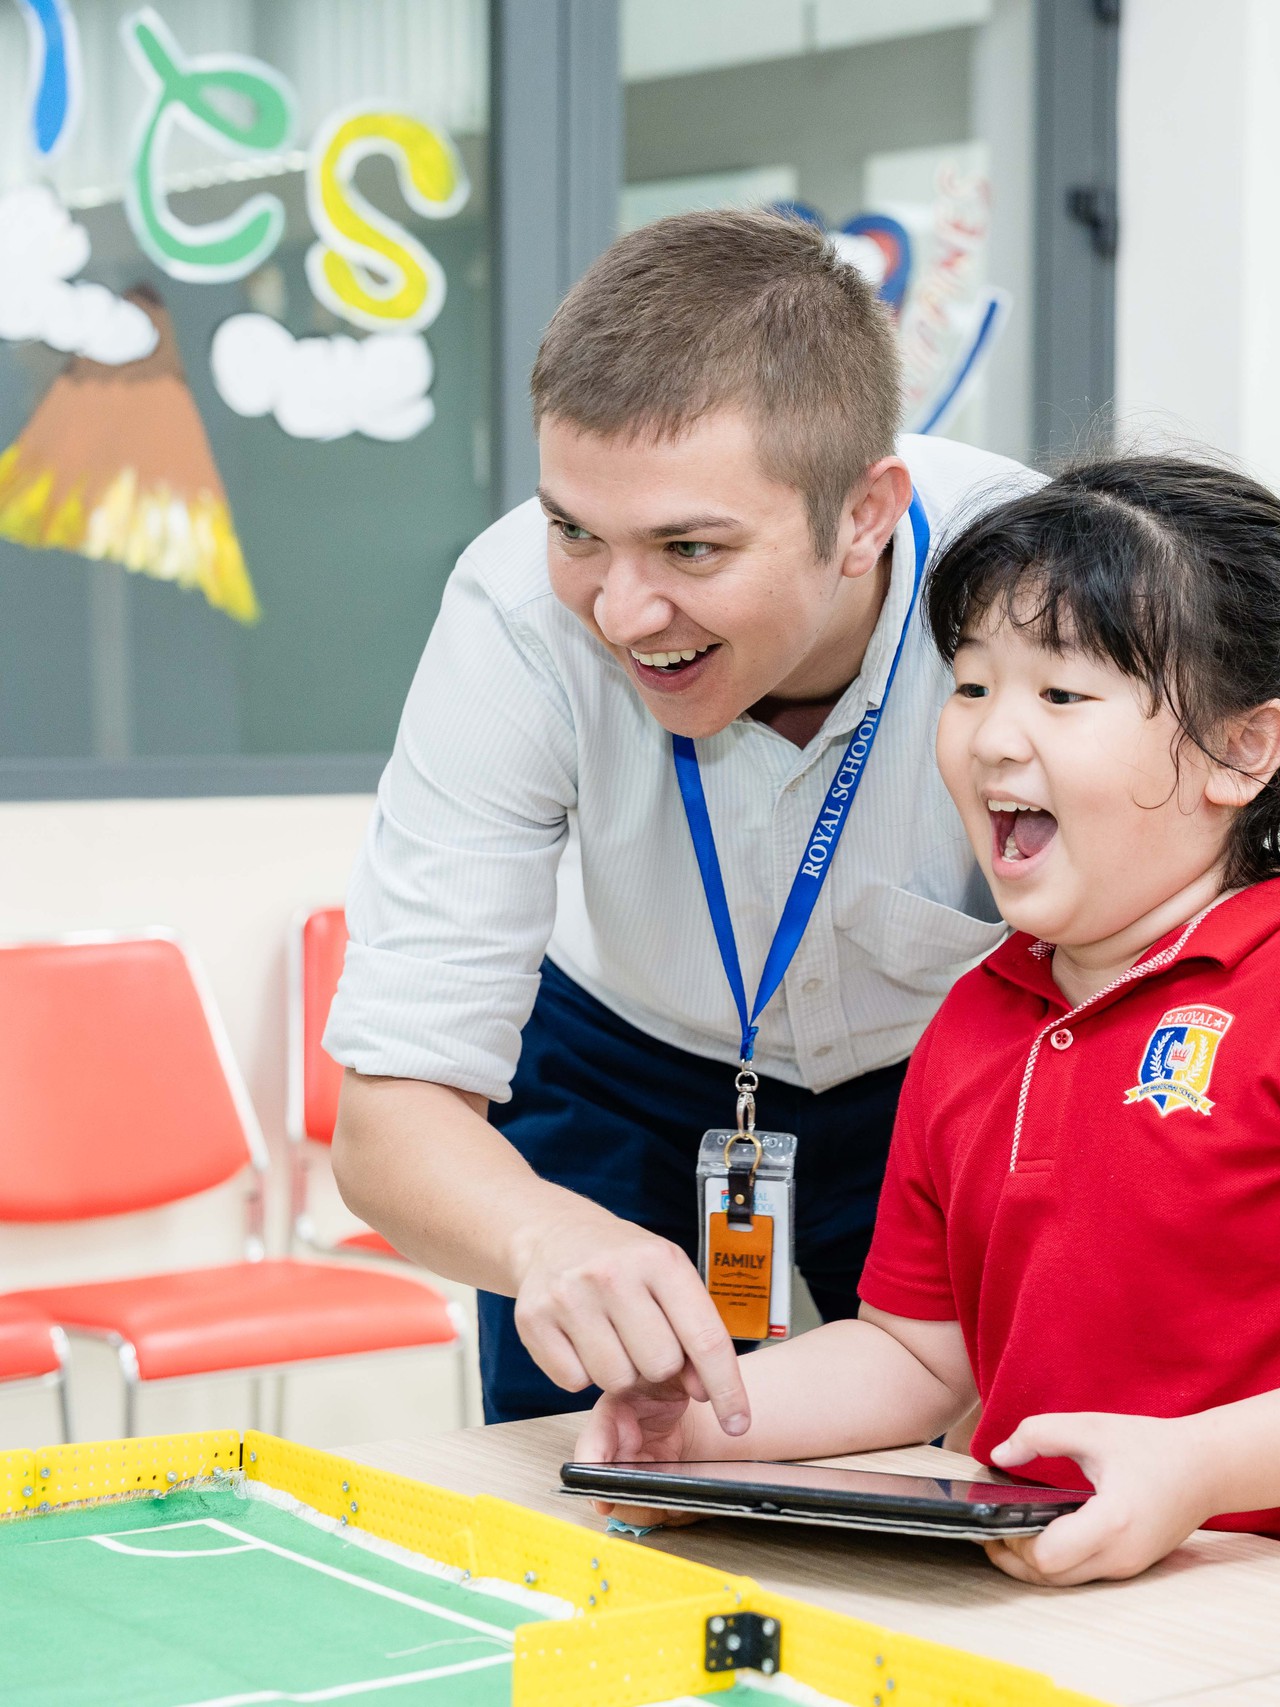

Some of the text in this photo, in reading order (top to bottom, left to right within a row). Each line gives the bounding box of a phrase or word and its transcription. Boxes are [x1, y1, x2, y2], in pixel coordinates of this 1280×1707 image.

[801, 711, 880, 879] ROYAL SCHOOL
[1174, 1011, 1214, 1027] ROYAL
[713, 1252, 766, 1269] FAMILY
